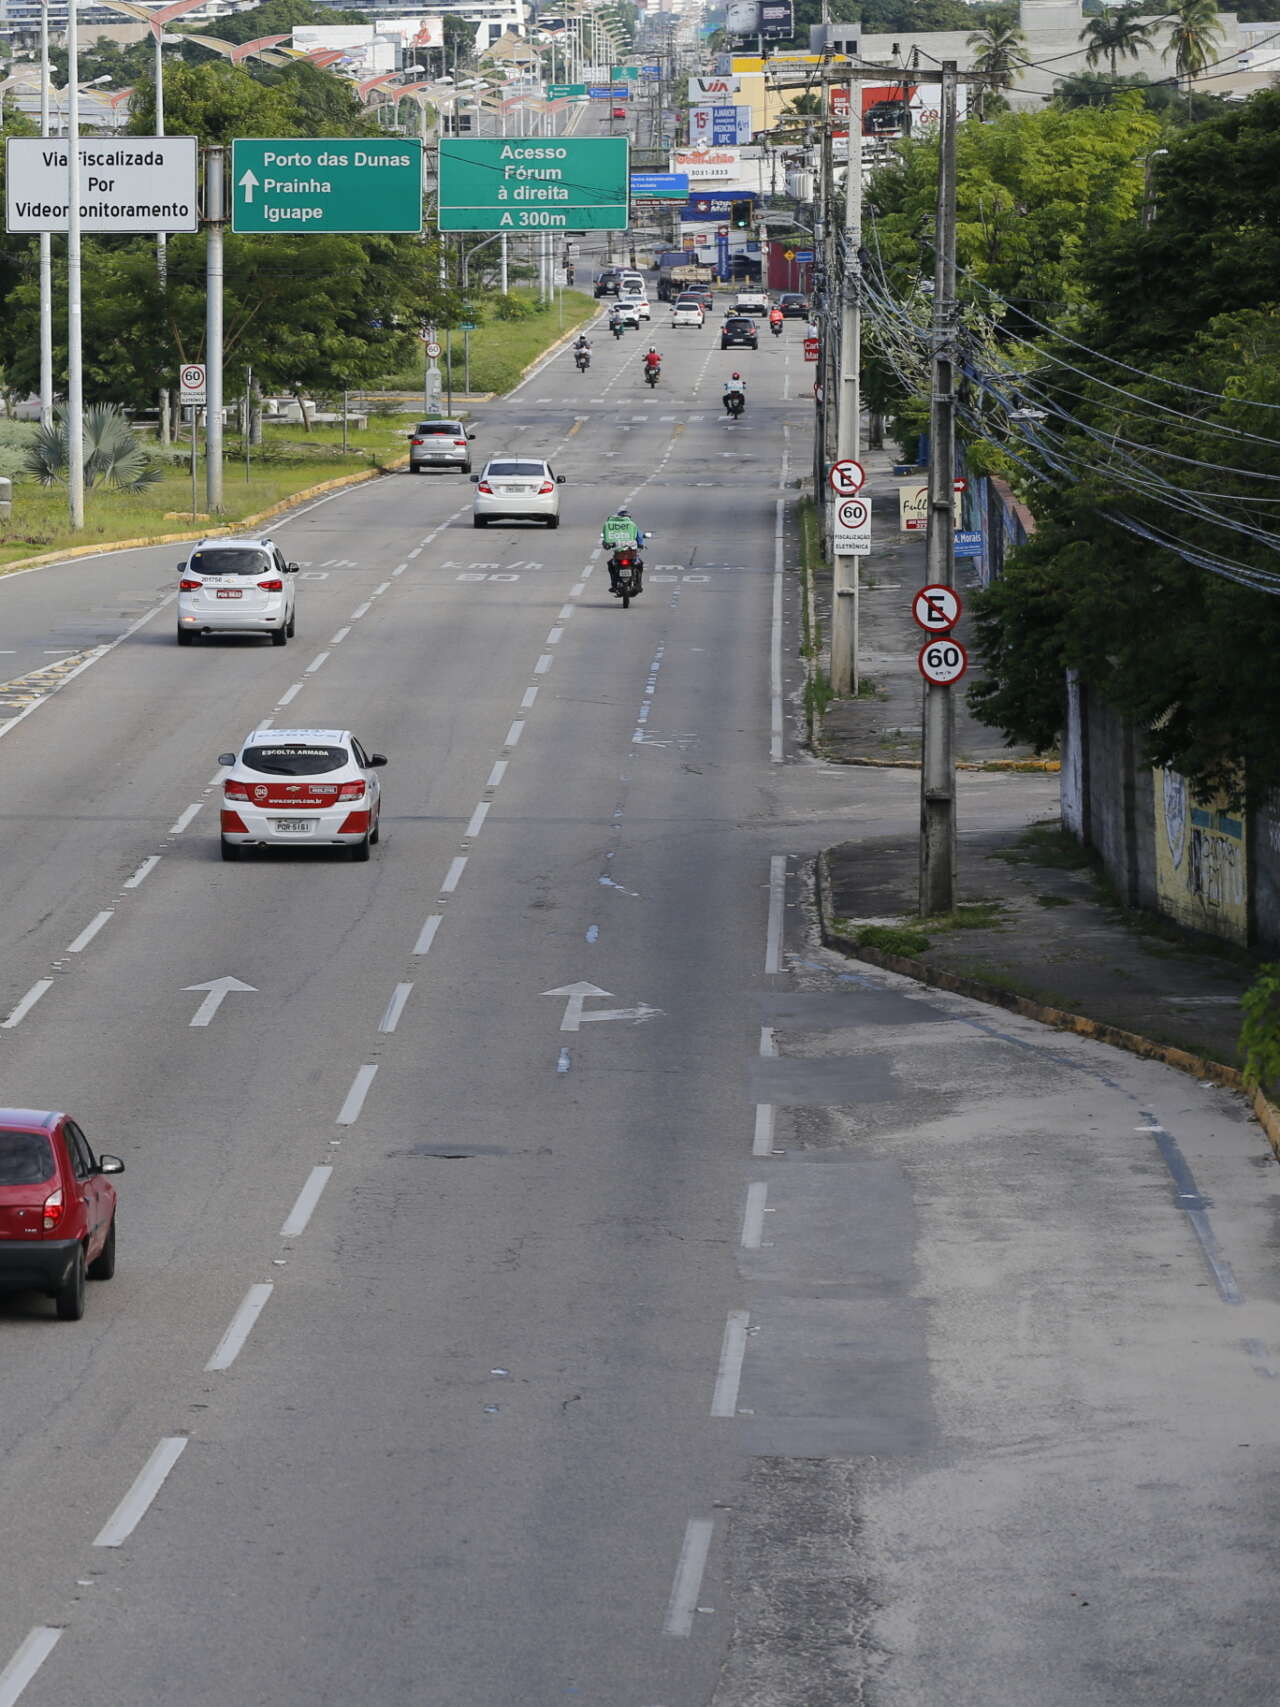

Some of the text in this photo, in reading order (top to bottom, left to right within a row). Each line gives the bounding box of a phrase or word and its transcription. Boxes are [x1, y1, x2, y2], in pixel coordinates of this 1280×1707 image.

[43, 152, 68, 167] Via
[264, 152, 411, 167] Porto das Dunas
[500, 145, 567, 160] Acesso
[504, 165, 562, 182] Fórum
[88, 177, 115, 192] Por
[264, 178, 332, 193] Prainha
[498, 185, 569, 200] à direita
[264, 205, 324, 222] Iguape
[500, 211, 567, 226] A 300m
[186, 371, 200, 380] 60
[843, 506, 863, 519] 60
[608, 523, 630, 531] Uber
[960, 532, 982, 543] Morais
[927, 647, 960, 668] 60
